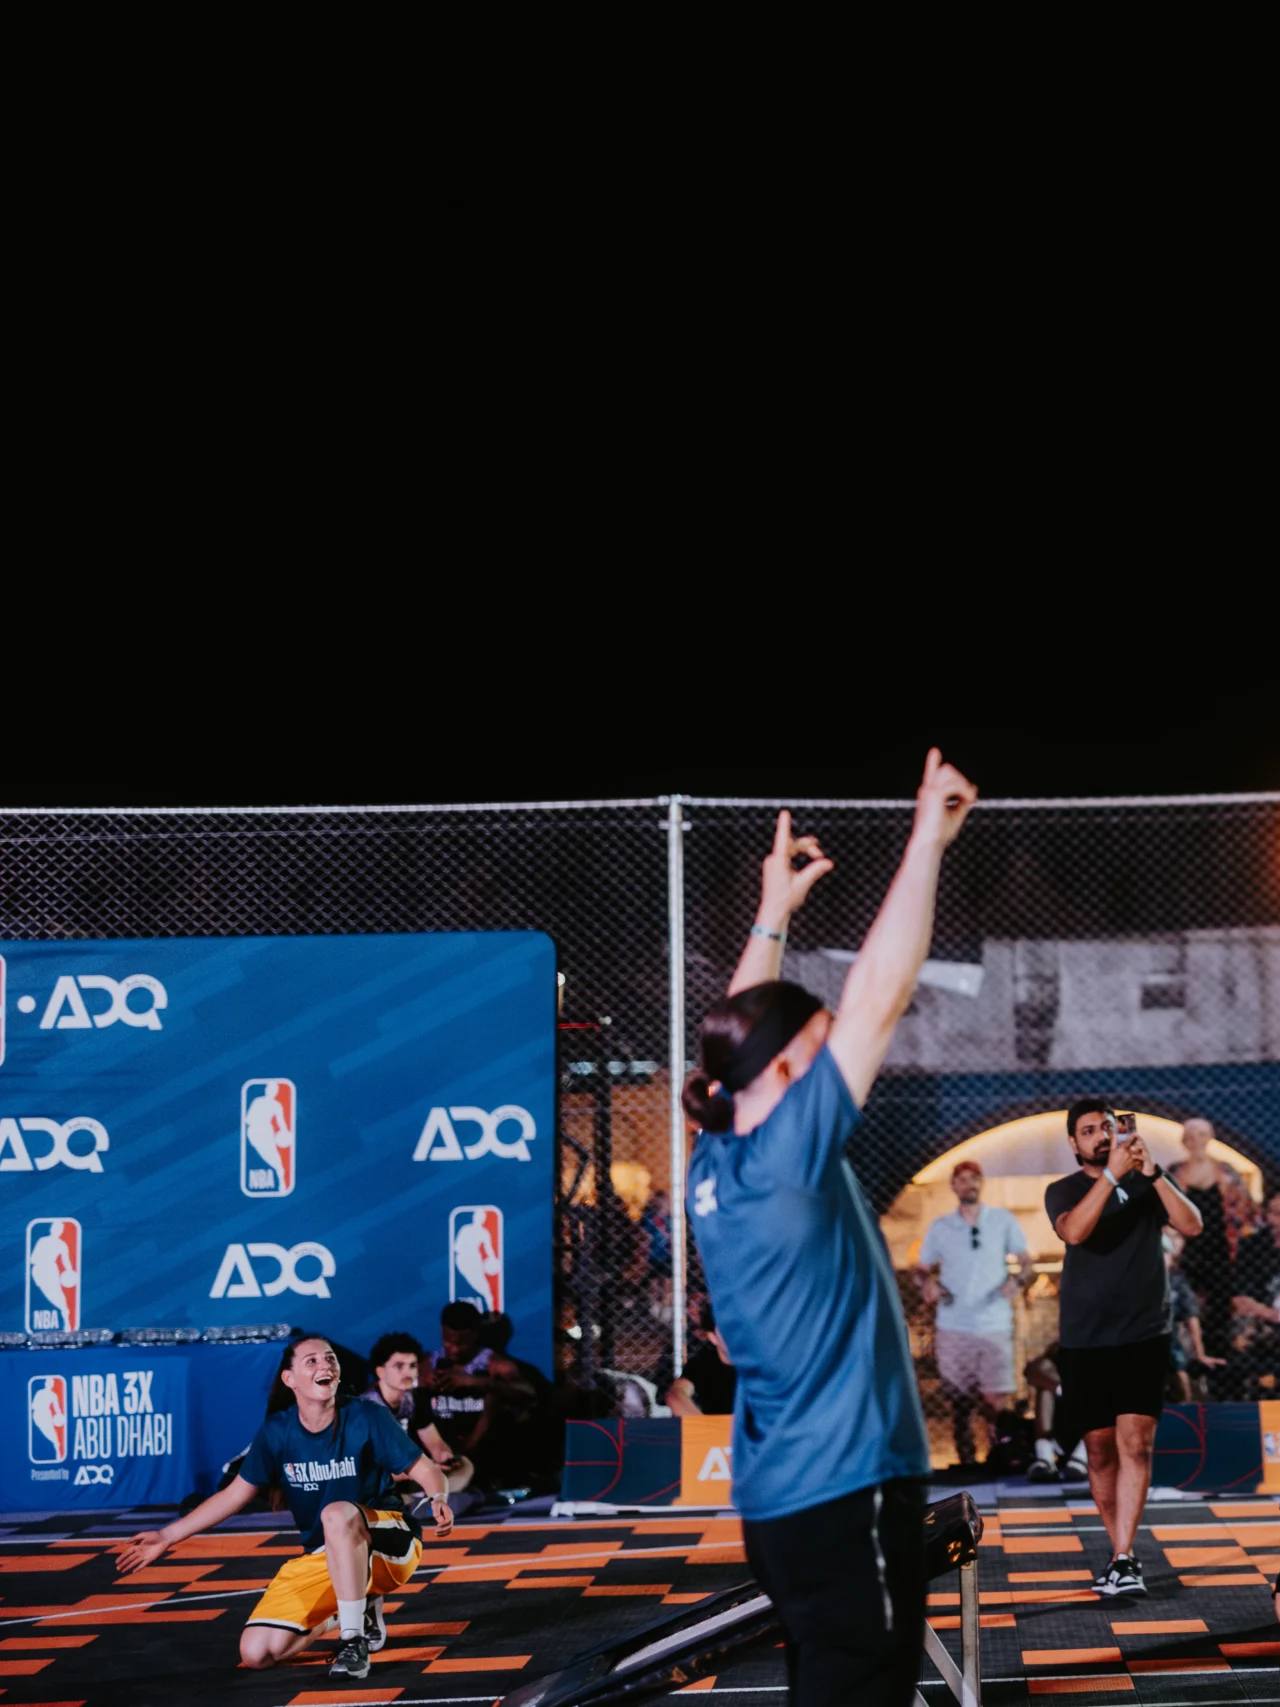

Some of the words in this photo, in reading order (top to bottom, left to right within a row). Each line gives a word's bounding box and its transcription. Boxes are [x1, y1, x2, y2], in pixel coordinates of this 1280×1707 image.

[39, 973, 168, 1031] ADQ
[0, 1116, 110, 1174] ADQ
[412, 1104, 537, 1162] ADQ
[249, 1169, 275, 1190] NBA
[208, 1241, 337, 1299] ADQ
[33, 1309, 60, 1329] NBA
[72, 1373, 120, 1418] NBA
[123, 1370, 154, 1414] 3X
[73, 1416, 112, 1460] ABU
[116, 1413, 173, 1458] DHABI
[73, 1464, 115, 1486] ADQ
[293, 1462, 309, 1482] 3X
[329, 1456, 357, 1480] habi
